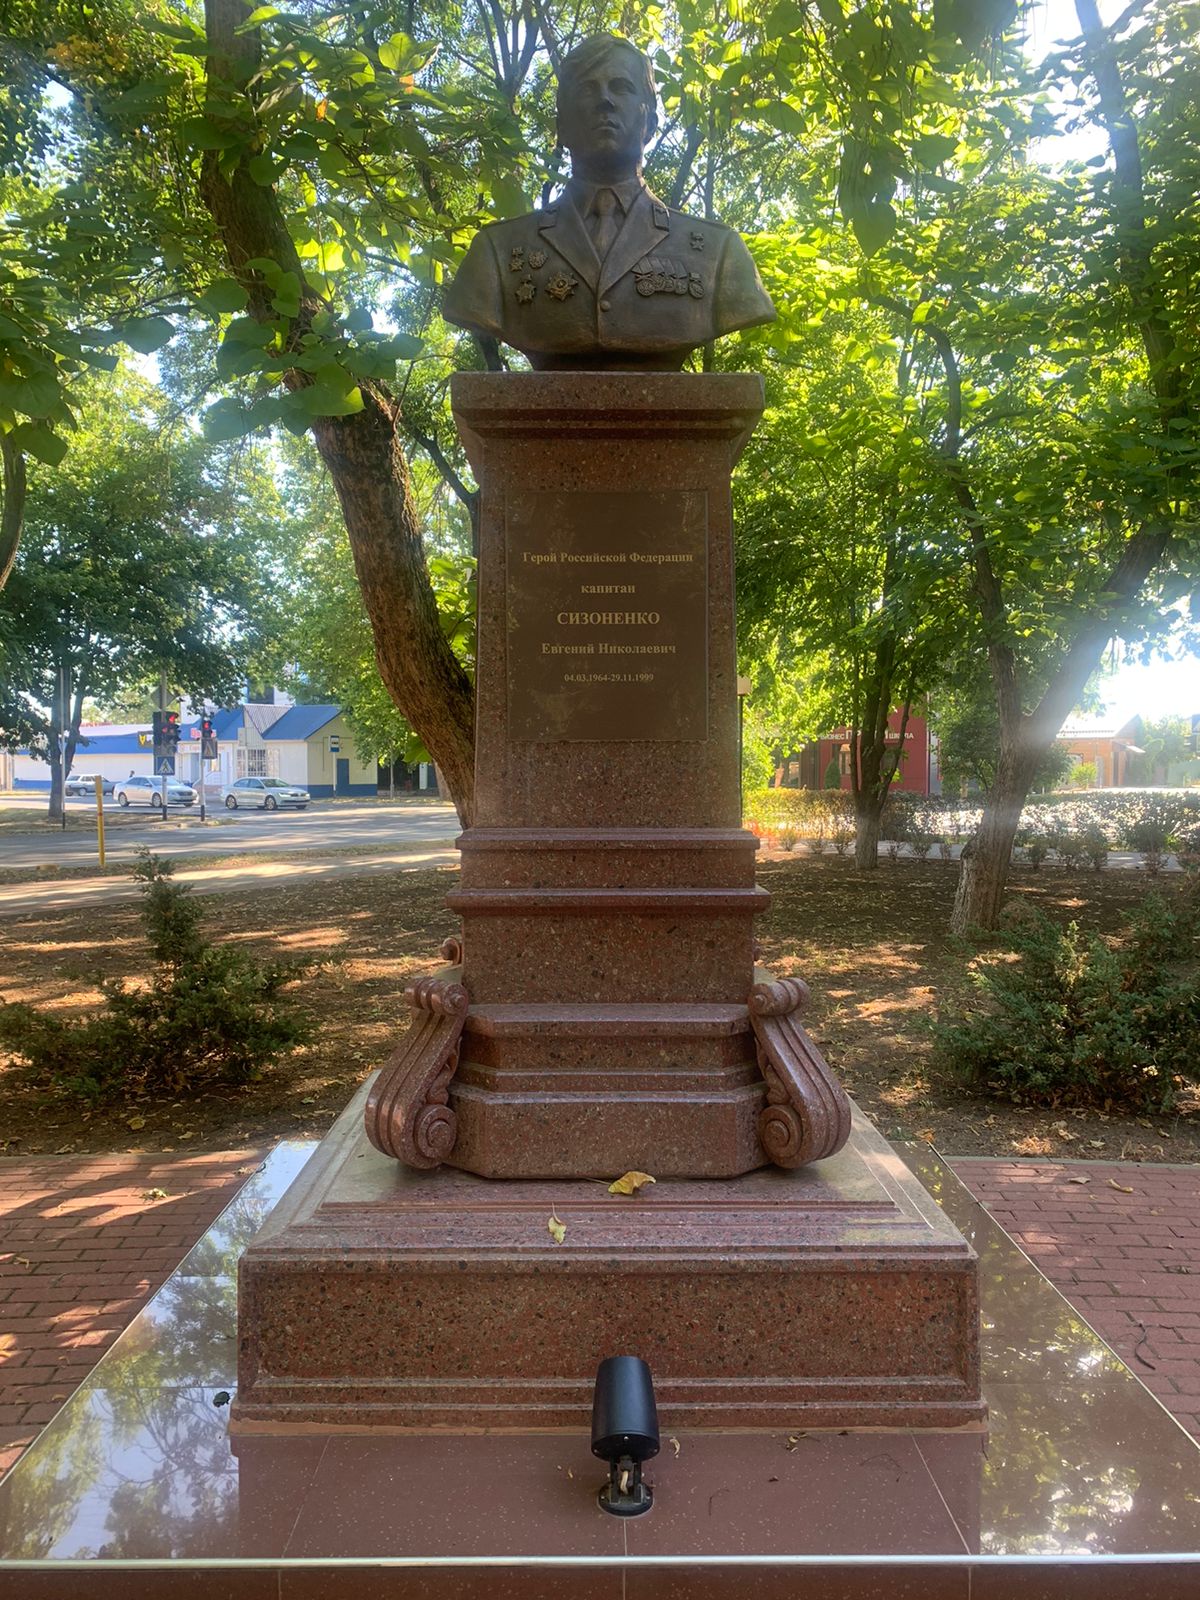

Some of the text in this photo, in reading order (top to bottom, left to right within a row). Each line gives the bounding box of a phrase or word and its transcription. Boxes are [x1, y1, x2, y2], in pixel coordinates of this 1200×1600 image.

[523, 551, 694, 564] Герой Российской Федерации
[581, 584, 635, 593] капитан
[557, 612, 660, 624] СИЗОНЕНКО
[542, 642, 676, 654] Евгений Николаевич
[564, 673, 654, 682] 04.03.1964-29.11.1999
